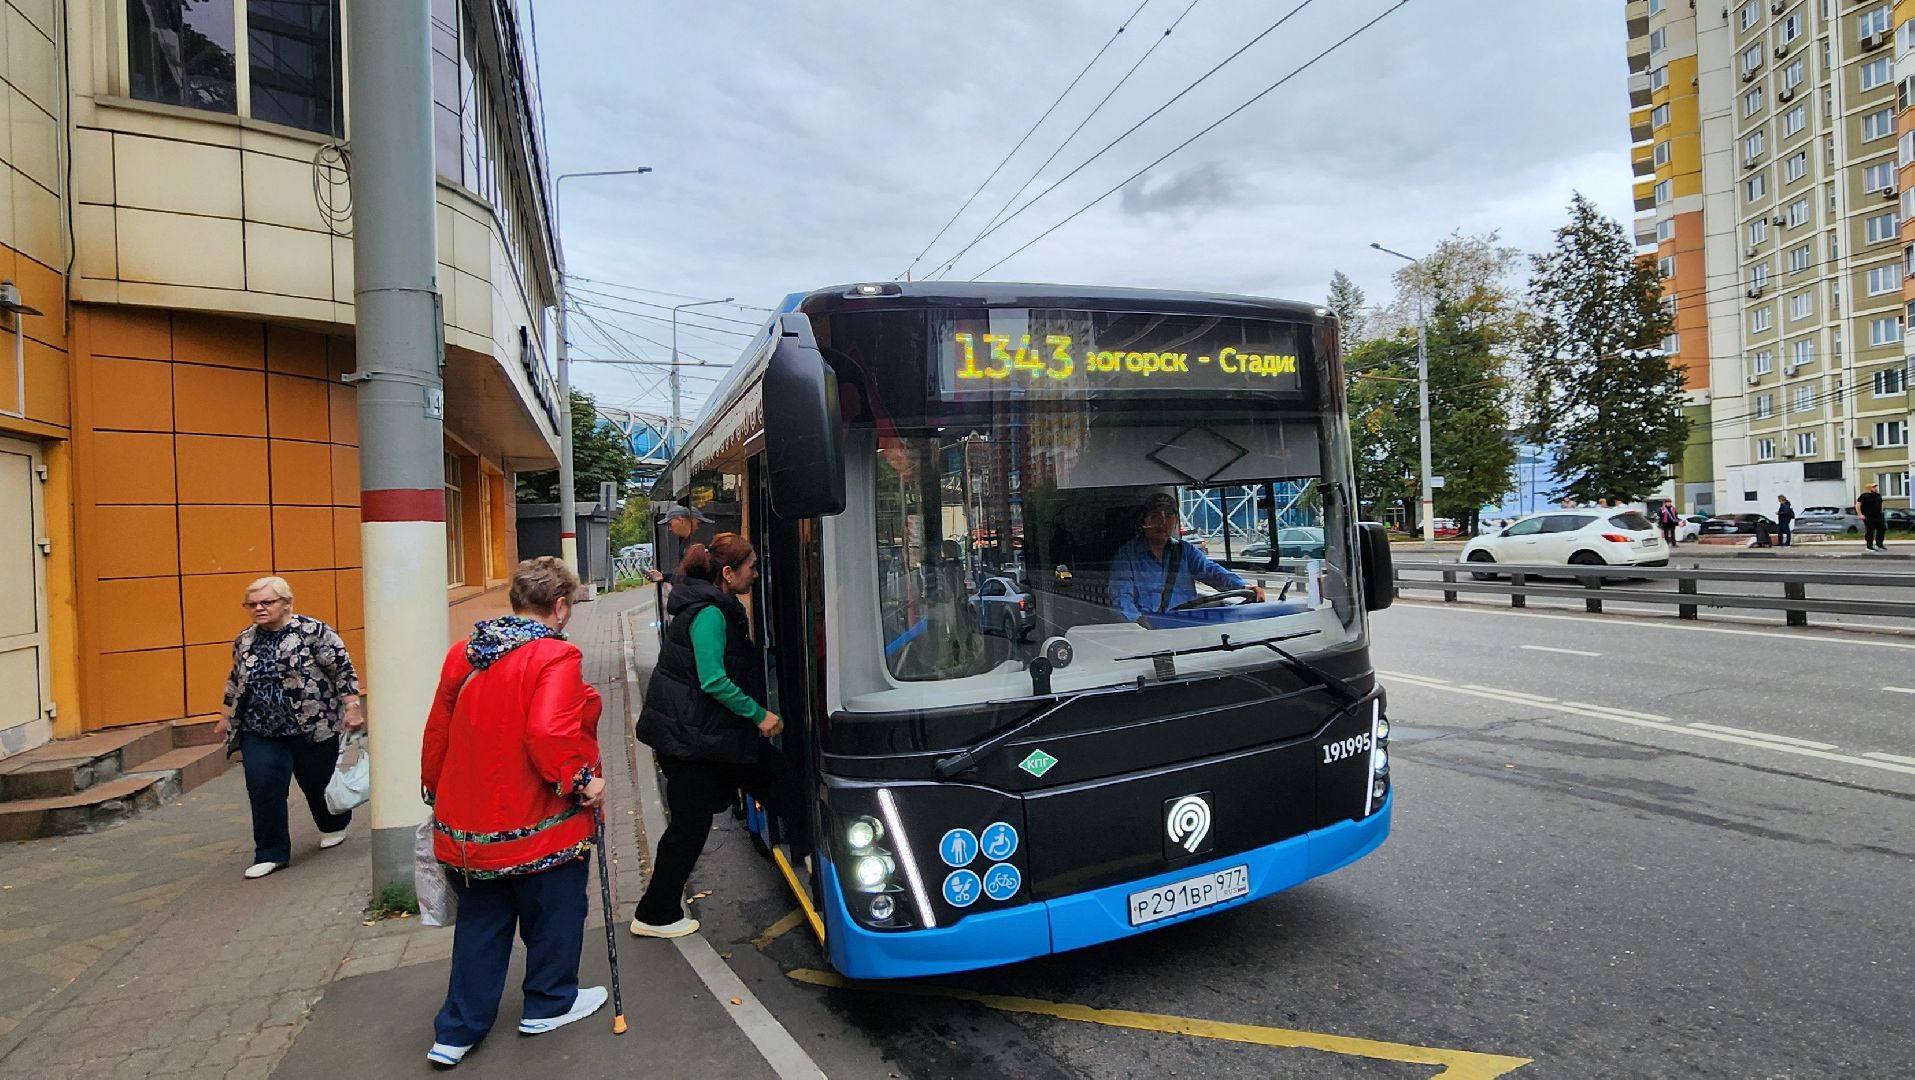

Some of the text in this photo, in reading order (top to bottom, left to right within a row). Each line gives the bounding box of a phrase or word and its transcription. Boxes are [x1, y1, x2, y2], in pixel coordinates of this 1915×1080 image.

[955, 332, 1074, 380] 1343
[1322, 732, 1371, 764] 191995
[1027, 757, 1049, 769] КПГ
[1216, 869, 1242, 890] 977
